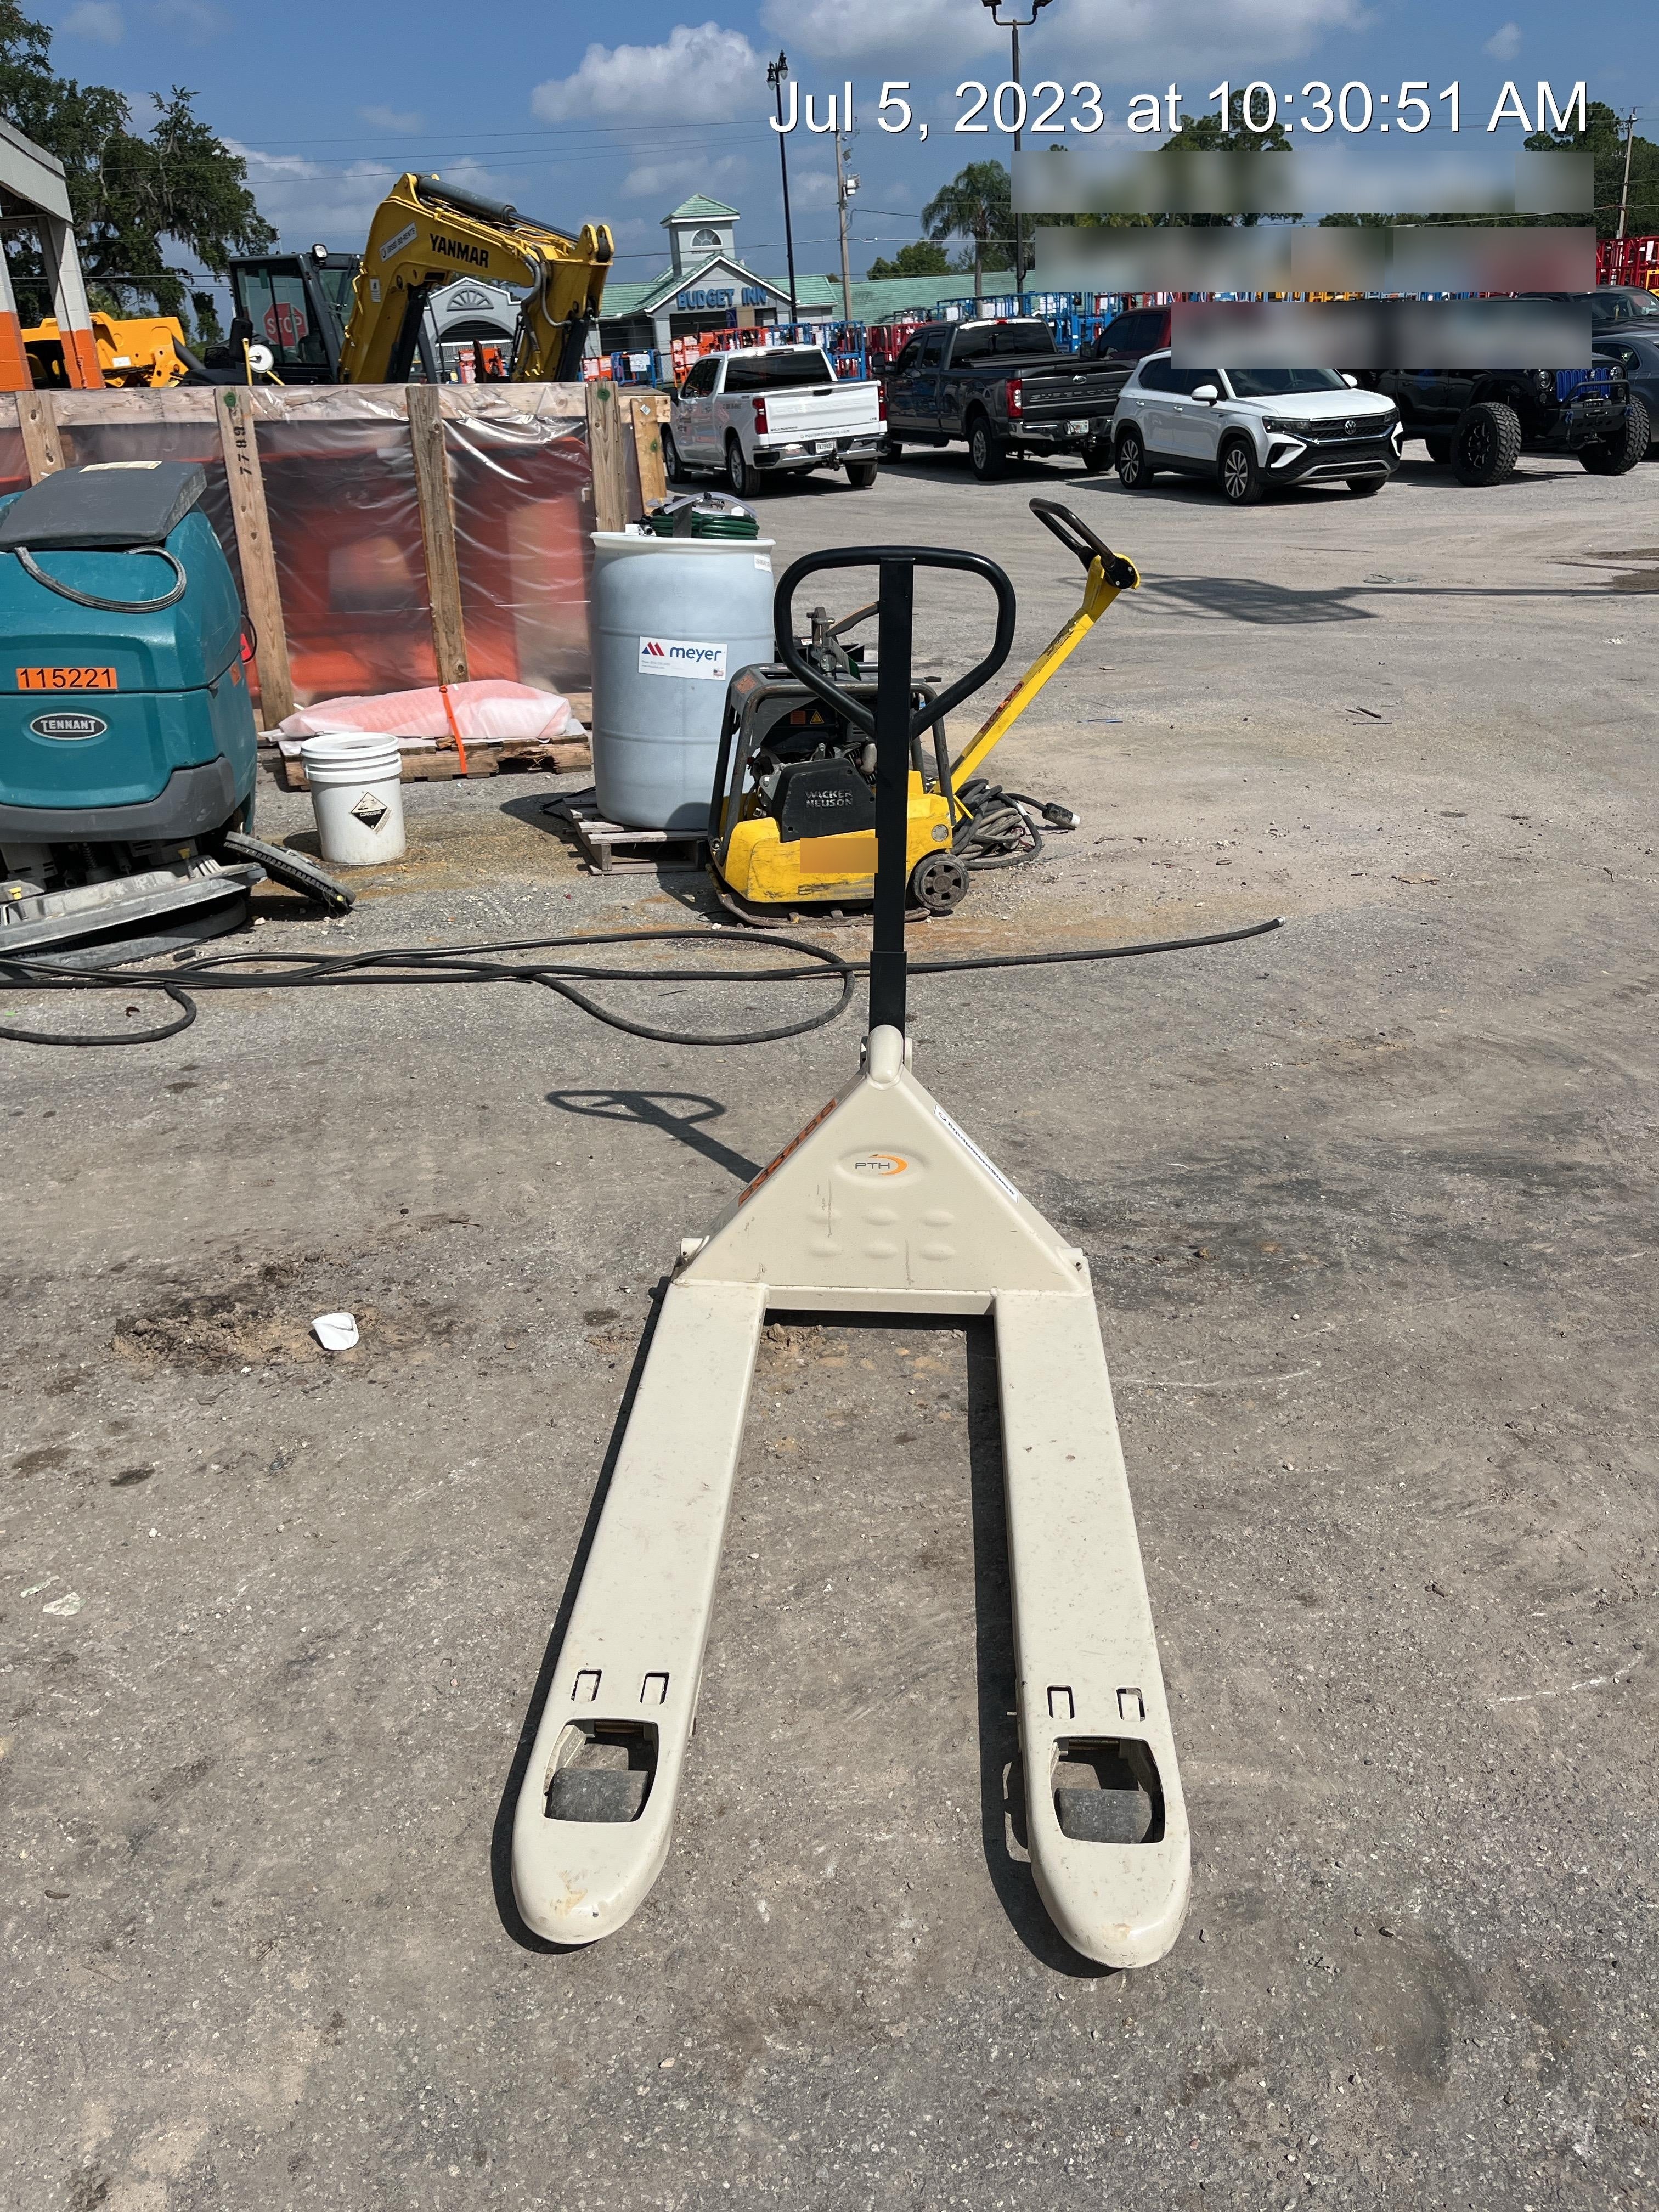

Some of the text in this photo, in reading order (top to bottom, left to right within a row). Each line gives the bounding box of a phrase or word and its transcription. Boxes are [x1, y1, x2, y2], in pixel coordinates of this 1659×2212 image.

[430, 233, 489, 268] YANMAR
[677, 286, 767, 310] BUDGET INN
[266, 316, 303, 334] STOP
[234, 426, 252, 475] 7789
[670, 647, 722, 663] meyer
[20, 668, 111, 688] 115221
[40, 720, 96, 733] TENNANT
[804, 789, 853, 799] WACKER
[805, 799, 852, 808] NEUSON
